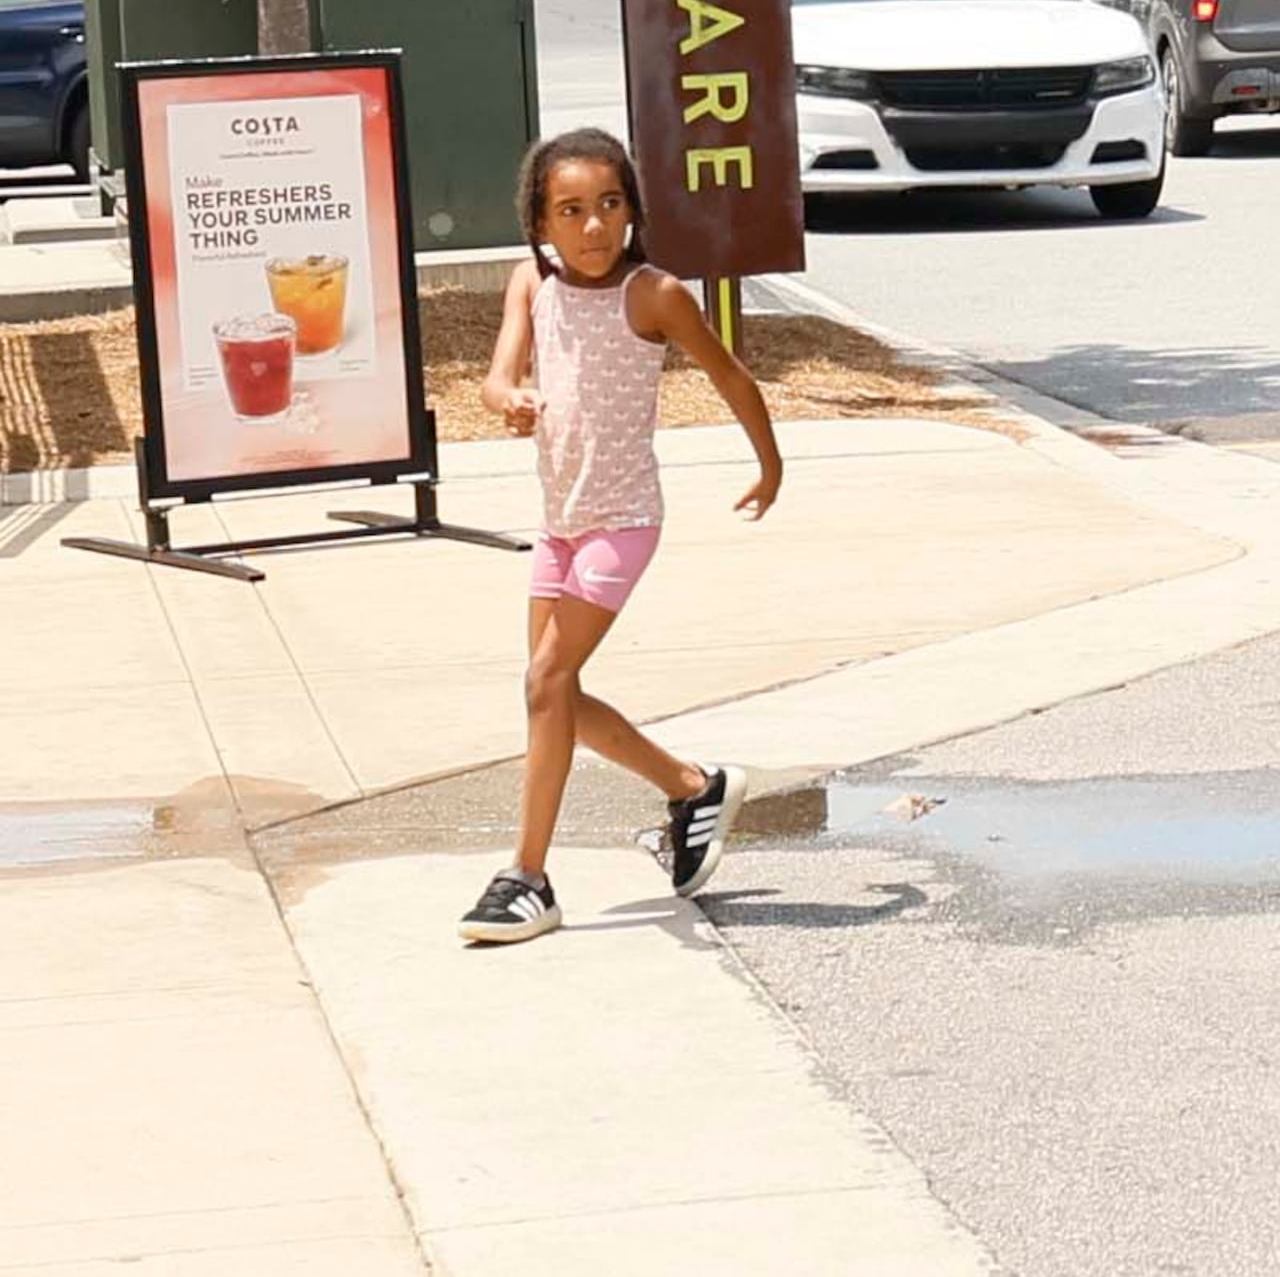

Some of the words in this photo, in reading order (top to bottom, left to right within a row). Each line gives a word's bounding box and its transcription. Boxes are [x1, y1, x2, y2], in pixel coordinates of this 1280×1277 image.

[230, 115, 300, 136] COSTA
[184, 175, 223, 188] Make
[186, 183, 333, 210] REFRESHERS
[188, 209, 249, 230] YOUR
[254, 203, 352, 226] SUMMER
[188, 228, 259, 250] THING
